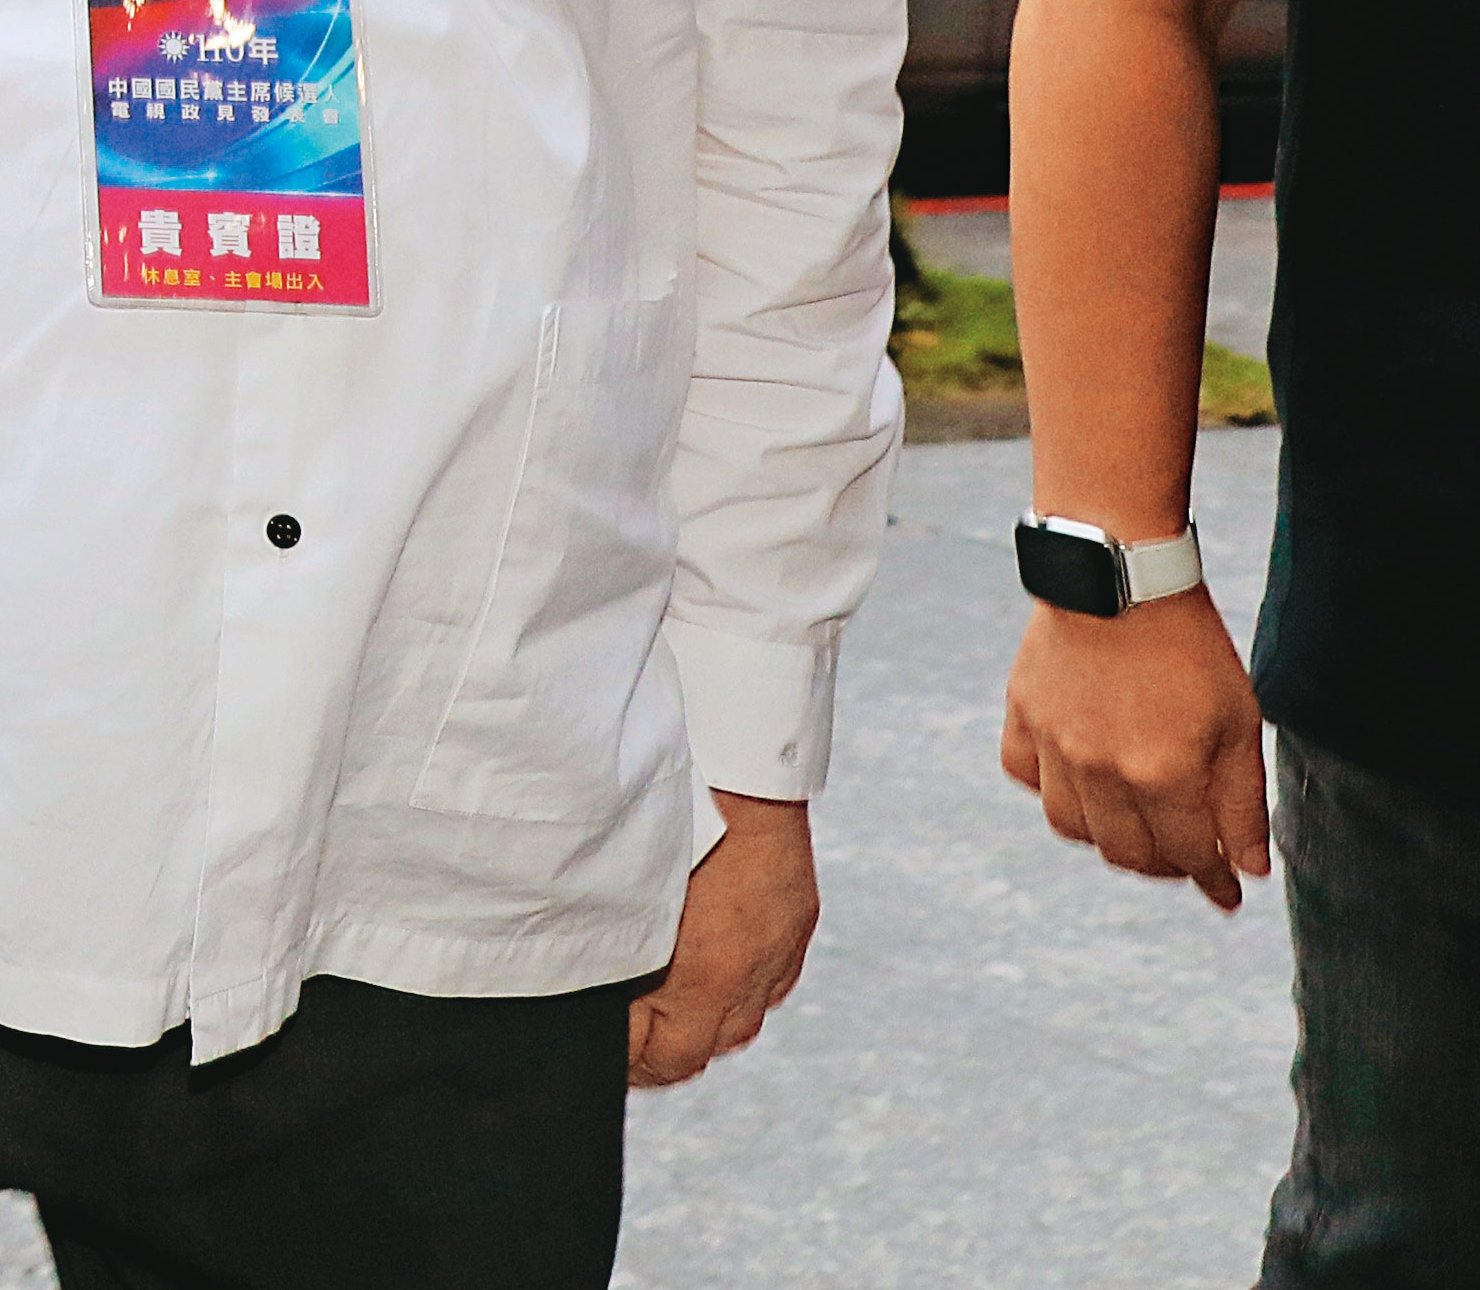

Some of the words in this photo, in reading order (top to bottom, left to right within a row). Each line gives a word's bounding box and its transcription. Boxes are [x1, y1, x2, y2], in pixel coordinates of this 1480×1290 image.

[108, 77, 340, 103] 中國國民黨主席候選人
[110, 101, 340, 126] 電視政見發表會
[137, 209, 322, 260] 貴賓證
[143, 268, 324, 291] 休息室、主會場出入
